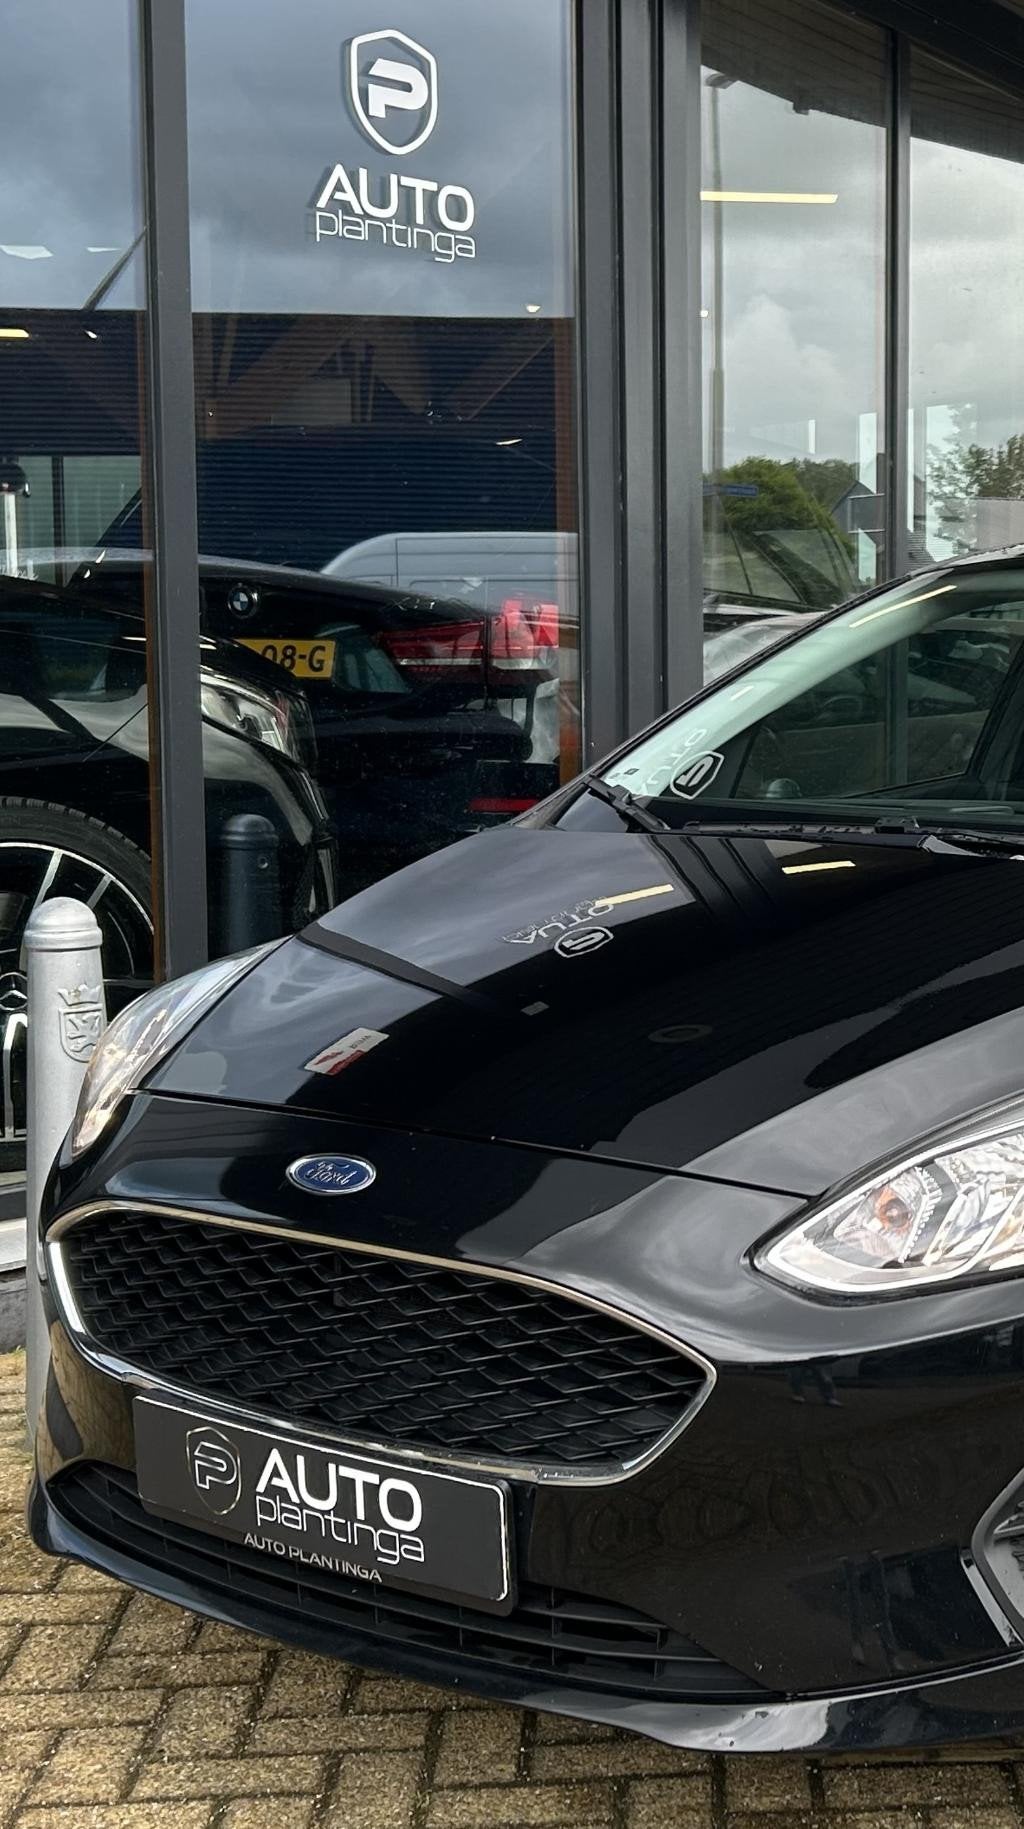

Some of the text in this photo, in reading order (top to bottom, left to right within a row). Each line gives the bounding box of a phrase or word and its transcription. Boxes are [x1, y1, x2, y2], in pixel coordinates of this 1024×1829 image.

[316, 163, 475, 232] AUTO
[316, 209, 475, 263] plantinga
[255, 1447, 422, 1532] AUTO
[244, 1532, 383, 1583] AUTO PLANTINGA
[255, 1495, 424, 1565] plantinga
